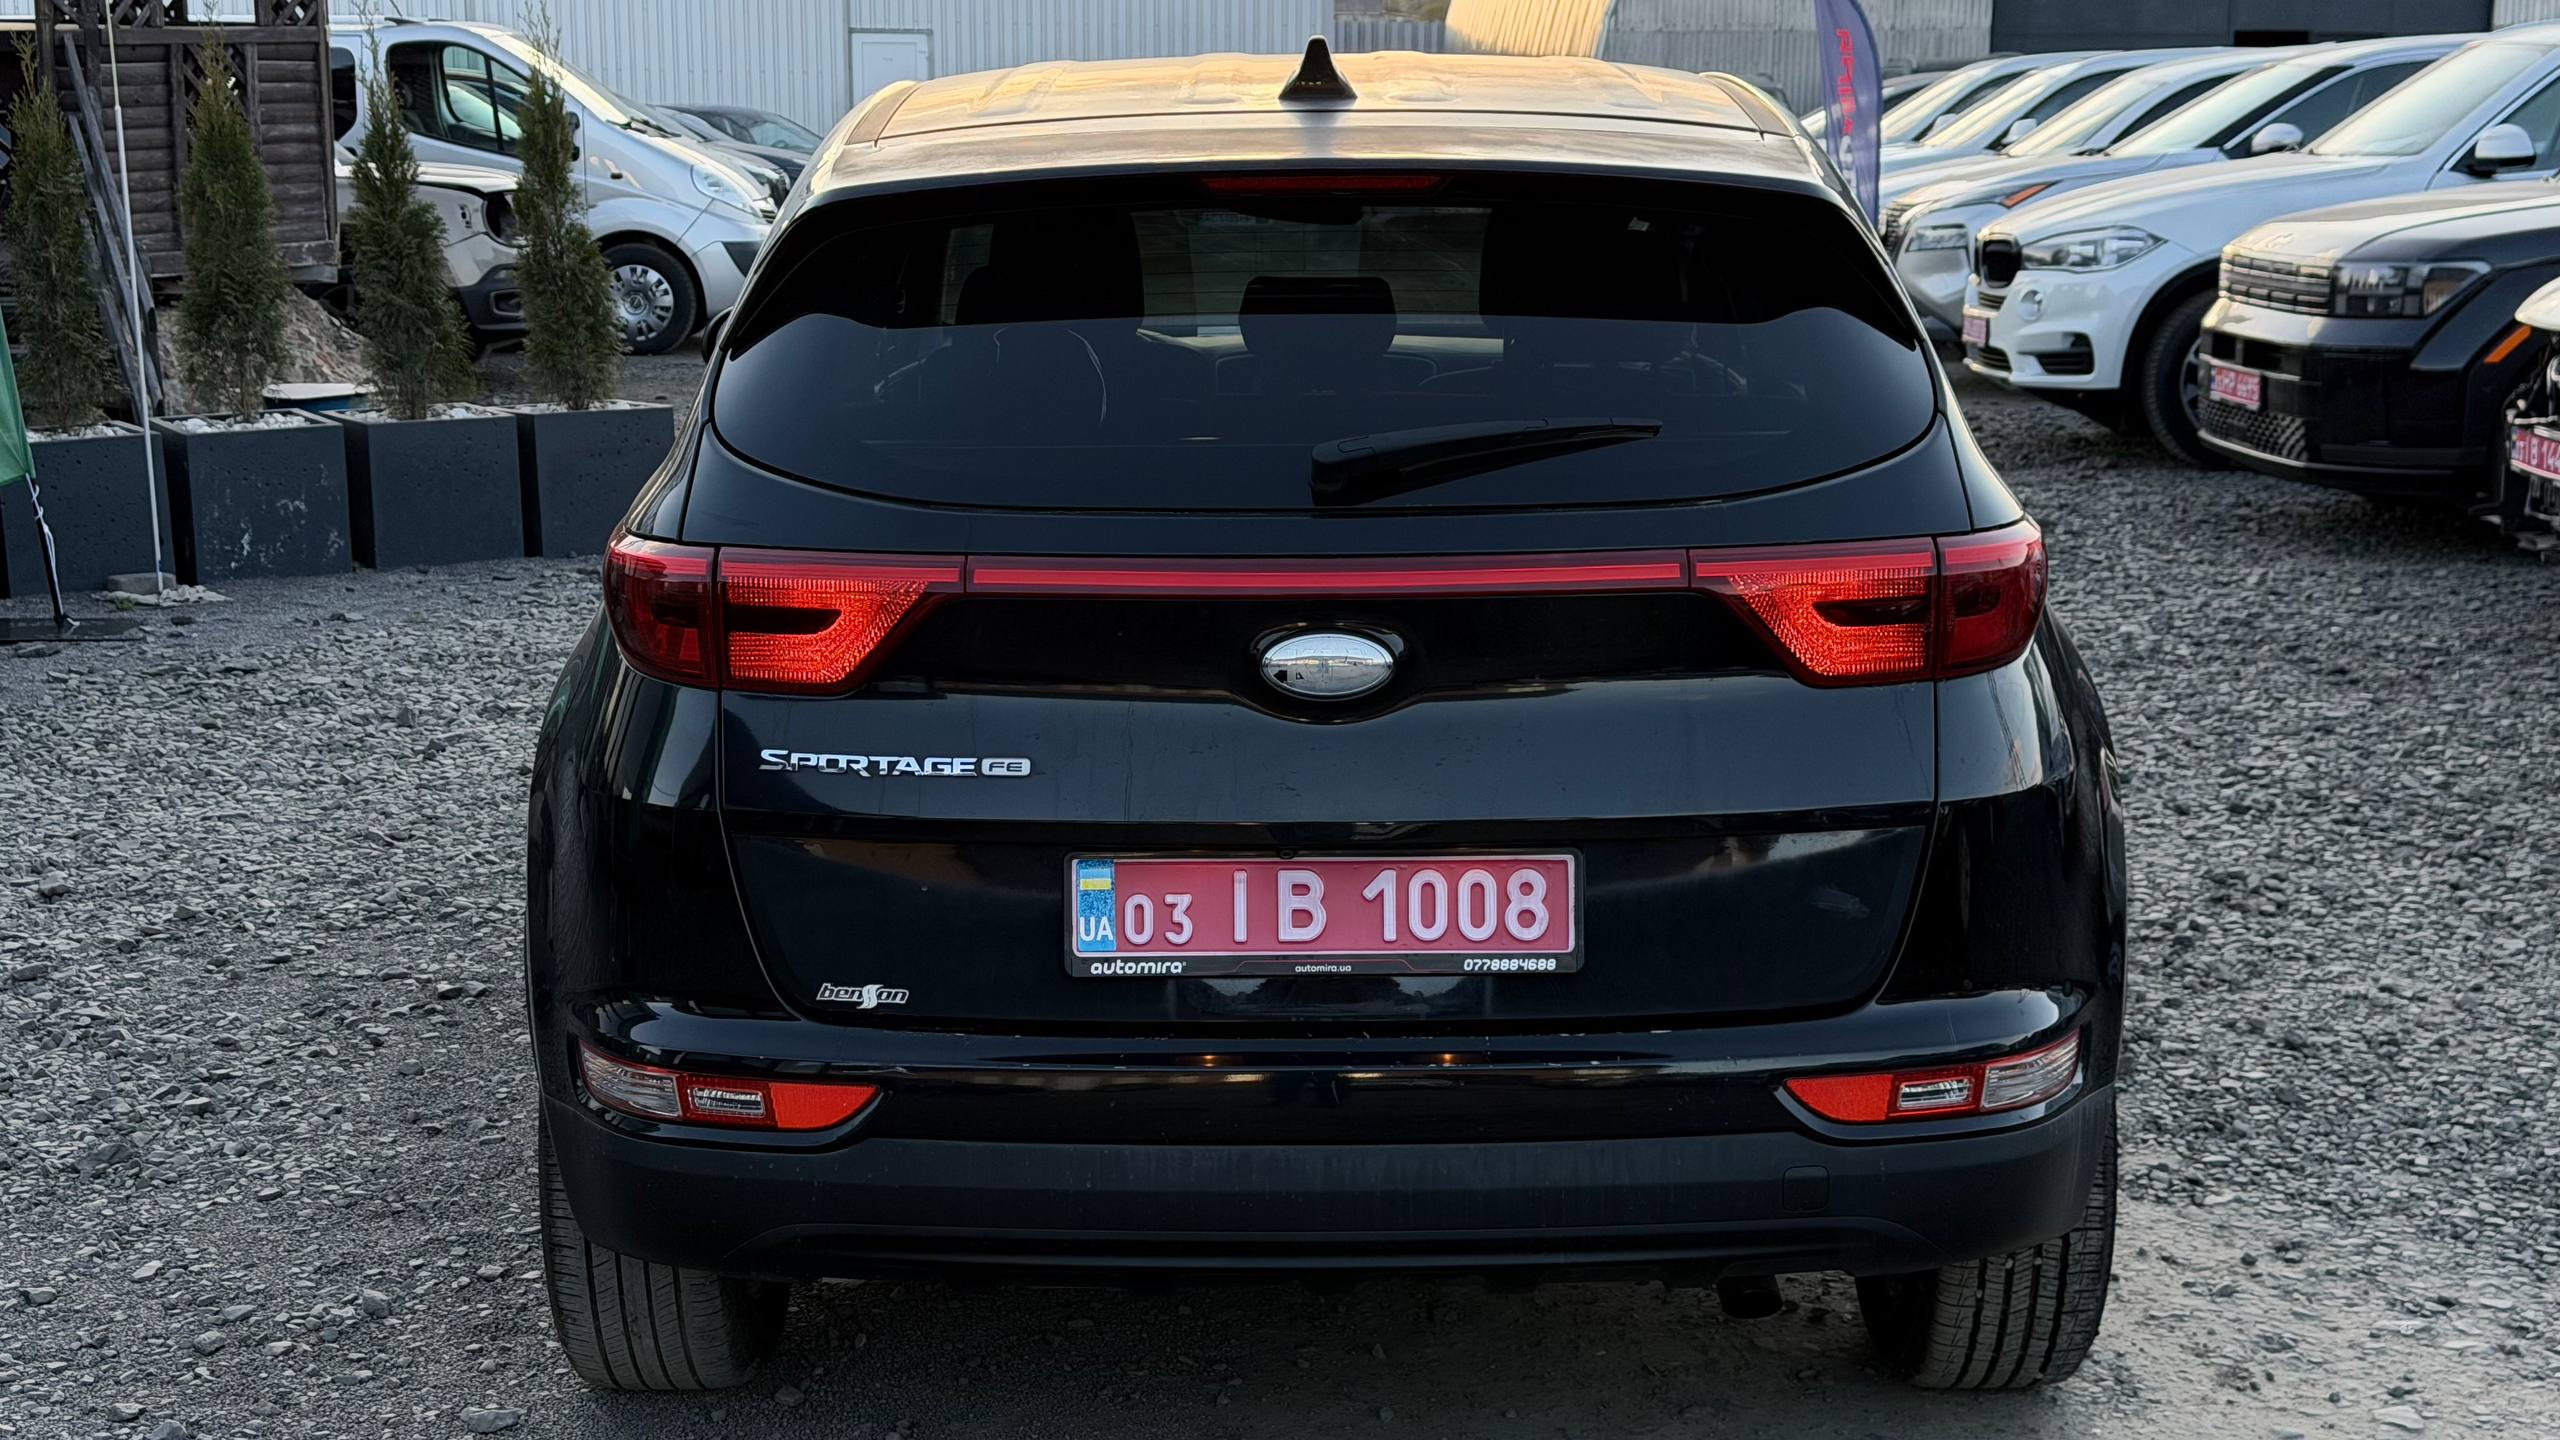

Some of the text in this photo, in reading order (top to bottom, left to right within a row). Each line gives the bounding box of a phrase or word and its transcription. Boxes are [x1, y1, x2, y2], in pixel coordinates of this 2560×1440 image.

[759, 749, 1025, 777] SPORTAGE FE
[1124, 894, 1193, 945] 03
[1362, 868, 1549, 942] 1008
[1079, 916, 1114, 941] UA
[1295, 963, 1351, 973] automira.ua
[1463, 958, 1557, 971] 0778884688
